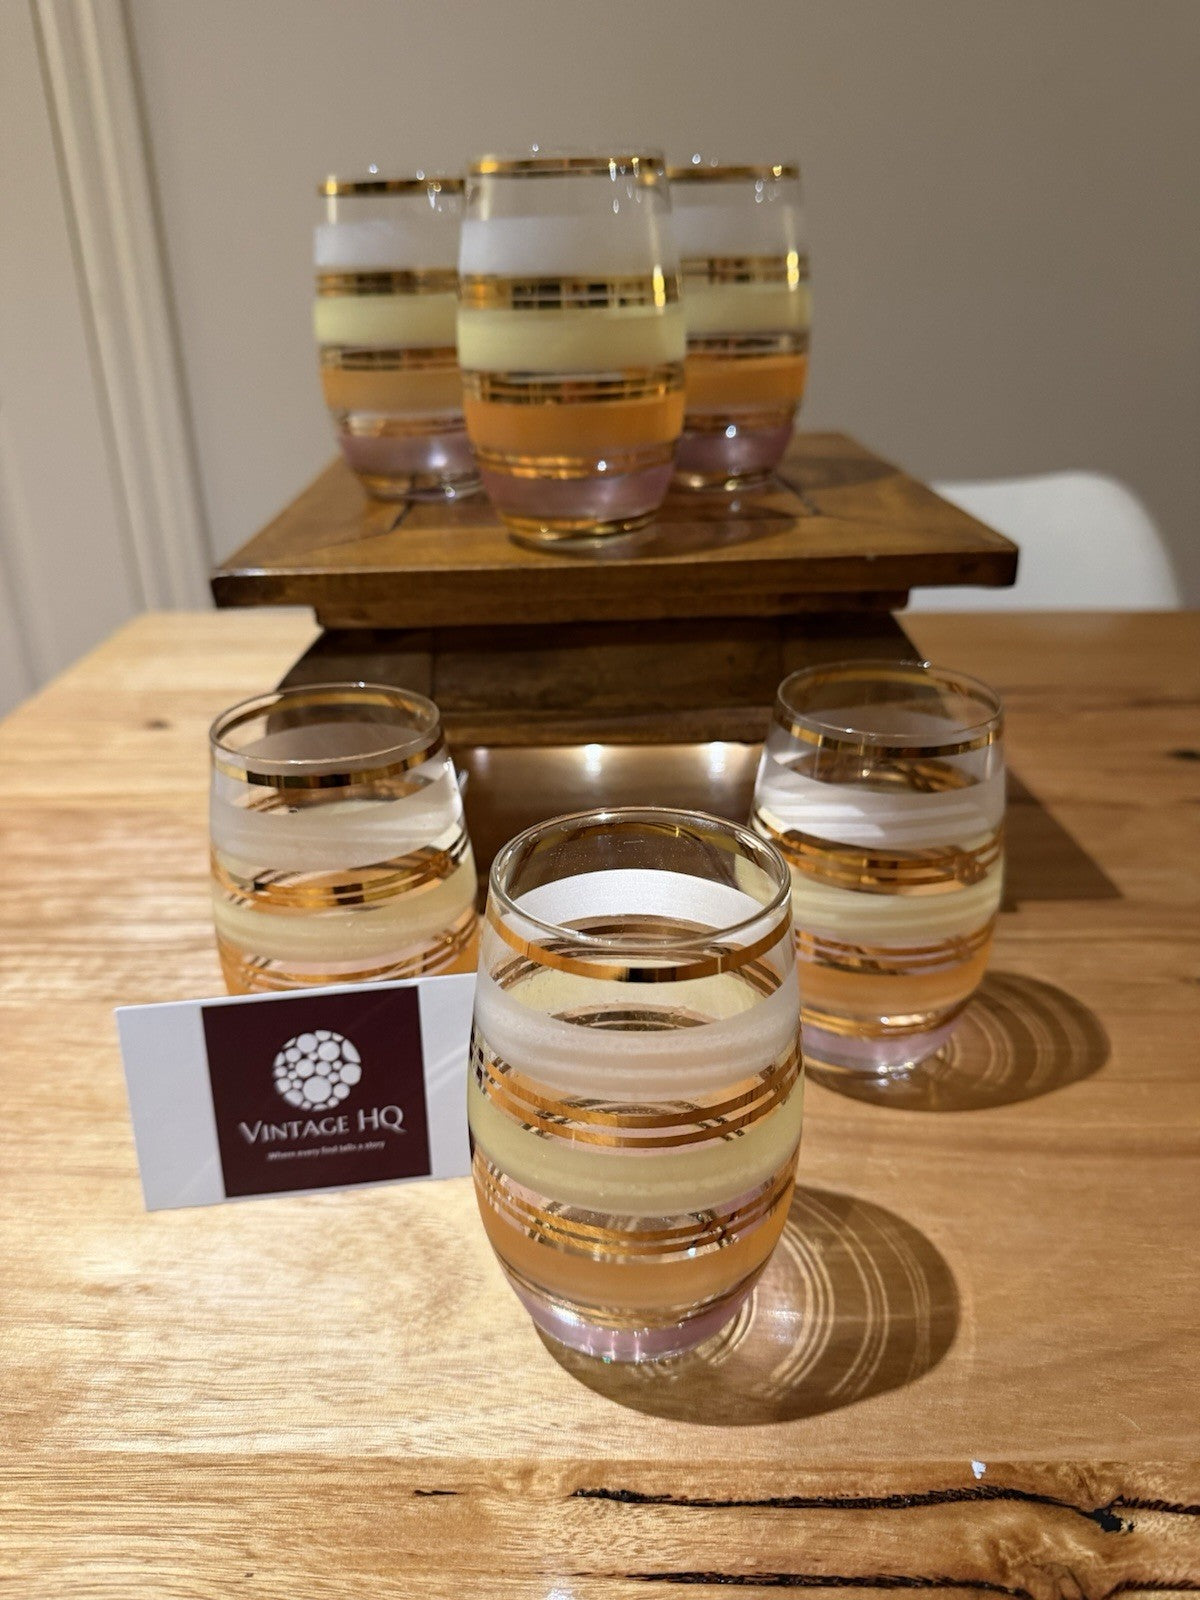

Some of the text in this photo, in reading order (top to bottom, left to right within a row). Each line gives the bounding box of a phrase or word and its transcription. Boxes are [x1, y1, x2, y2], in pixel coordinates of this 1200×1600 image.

[357, 1105, 407, 1133] HQ
[297, 1149, 320, 1158] every
[364, 1141, 386, 1150] story
